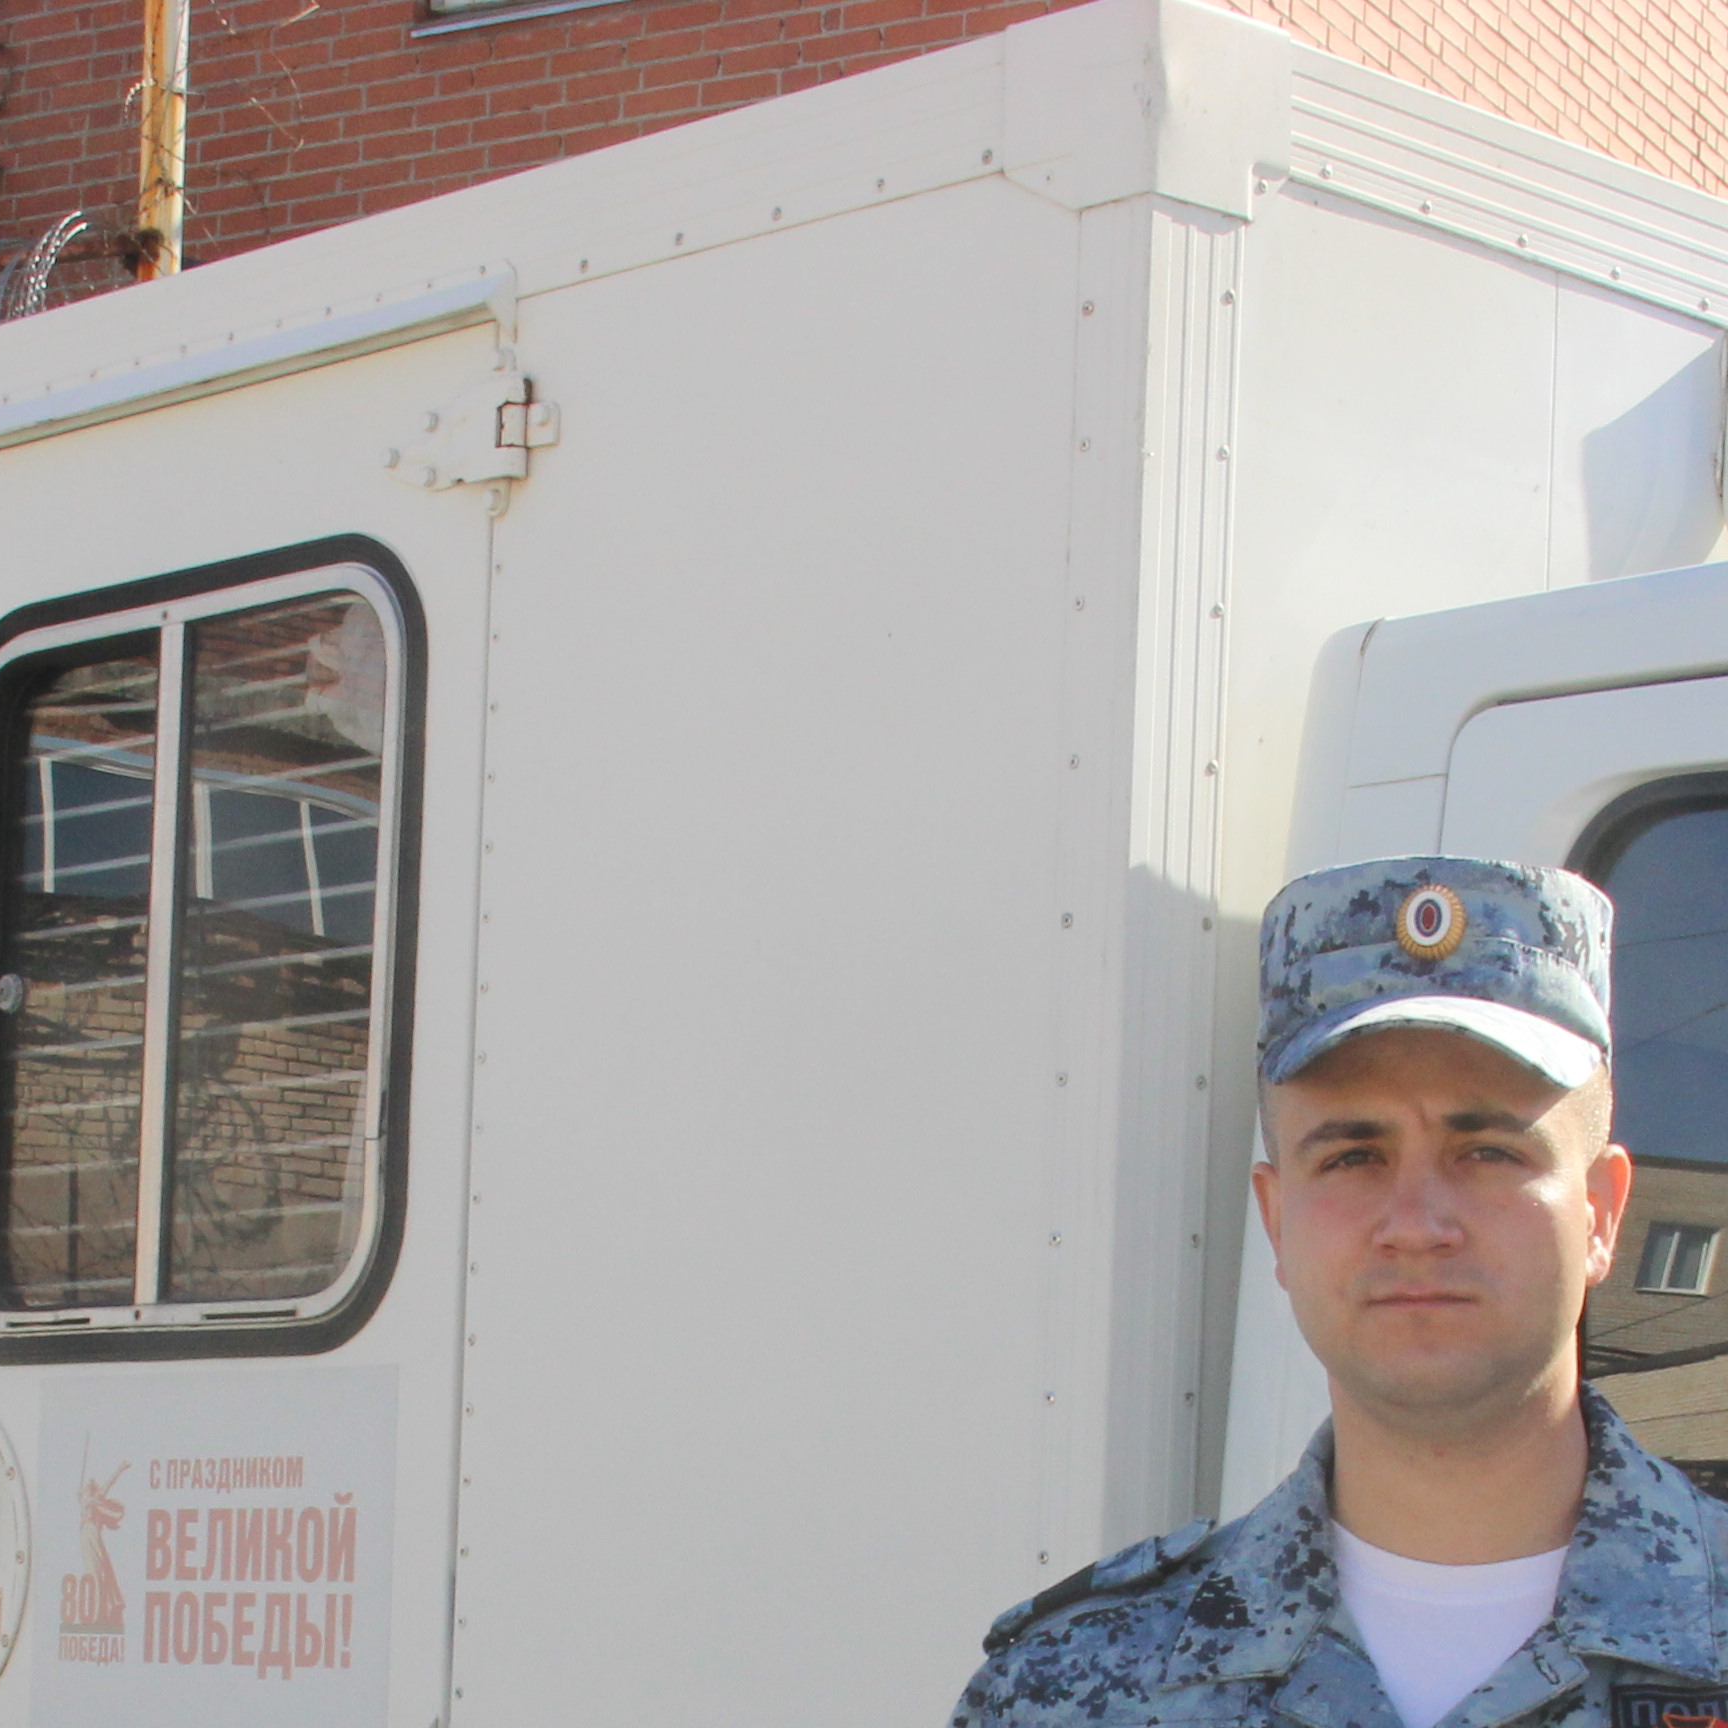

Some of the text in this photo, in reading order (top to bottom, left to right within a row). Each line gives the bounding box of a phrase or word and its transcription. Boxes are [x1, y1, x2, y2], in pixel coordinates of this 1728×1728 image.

[149, 1455, 305, 1494] С ПРАЗДНИКОМ
[145, 1491, 358, 1584] ВЕЛИКОЙ
[142, 1590, 354, 1681] ПОБЕДЫ!
